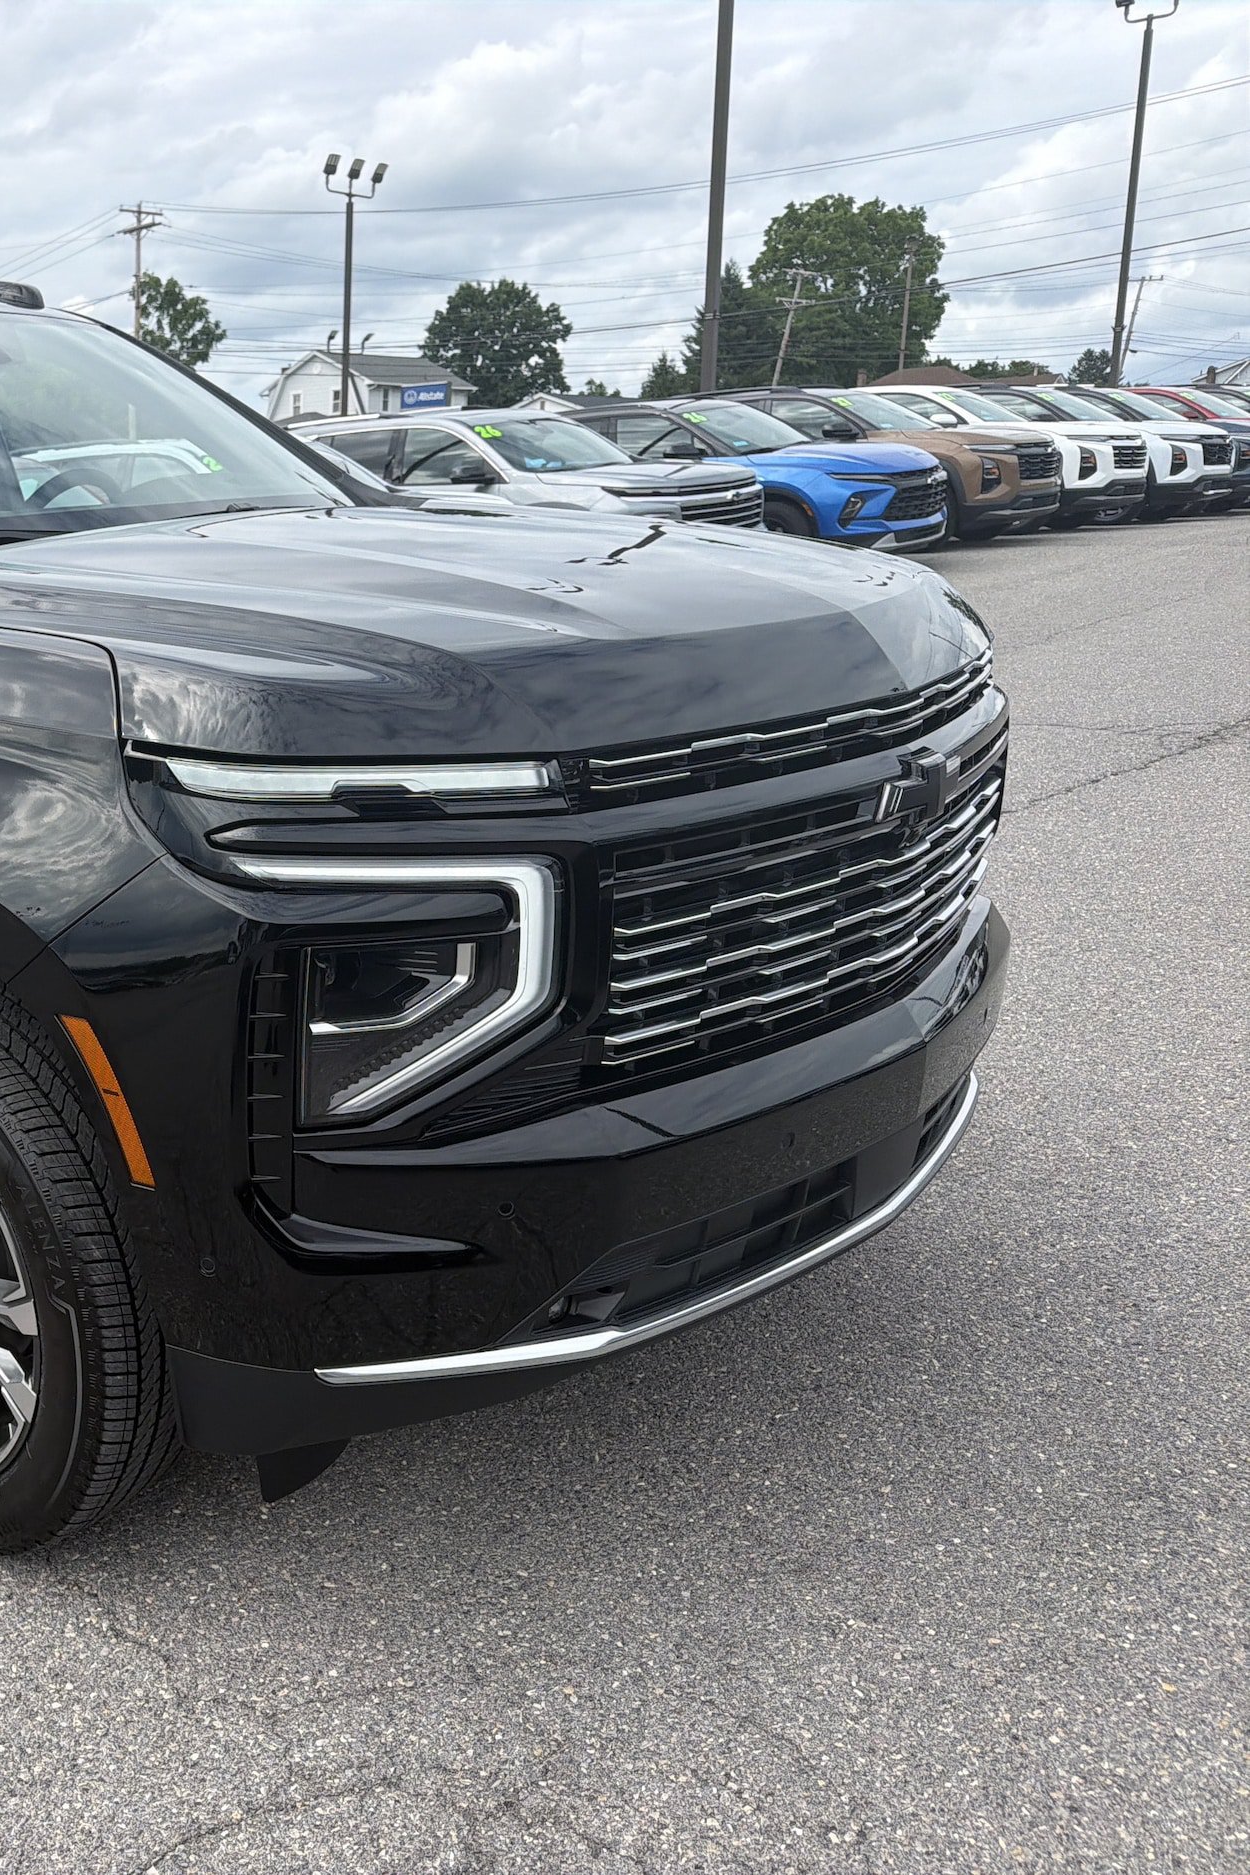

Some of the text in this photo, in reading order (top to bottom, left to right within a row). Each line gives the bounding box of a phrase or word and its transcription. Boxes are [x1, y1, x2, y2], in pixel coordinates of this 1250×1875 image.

[682, 411, 708, 423] 26
[474, 425, 502, 438] 26
[202, 456, 223, 472] 2
[15, 1184, 67, 1291] ALENZA
